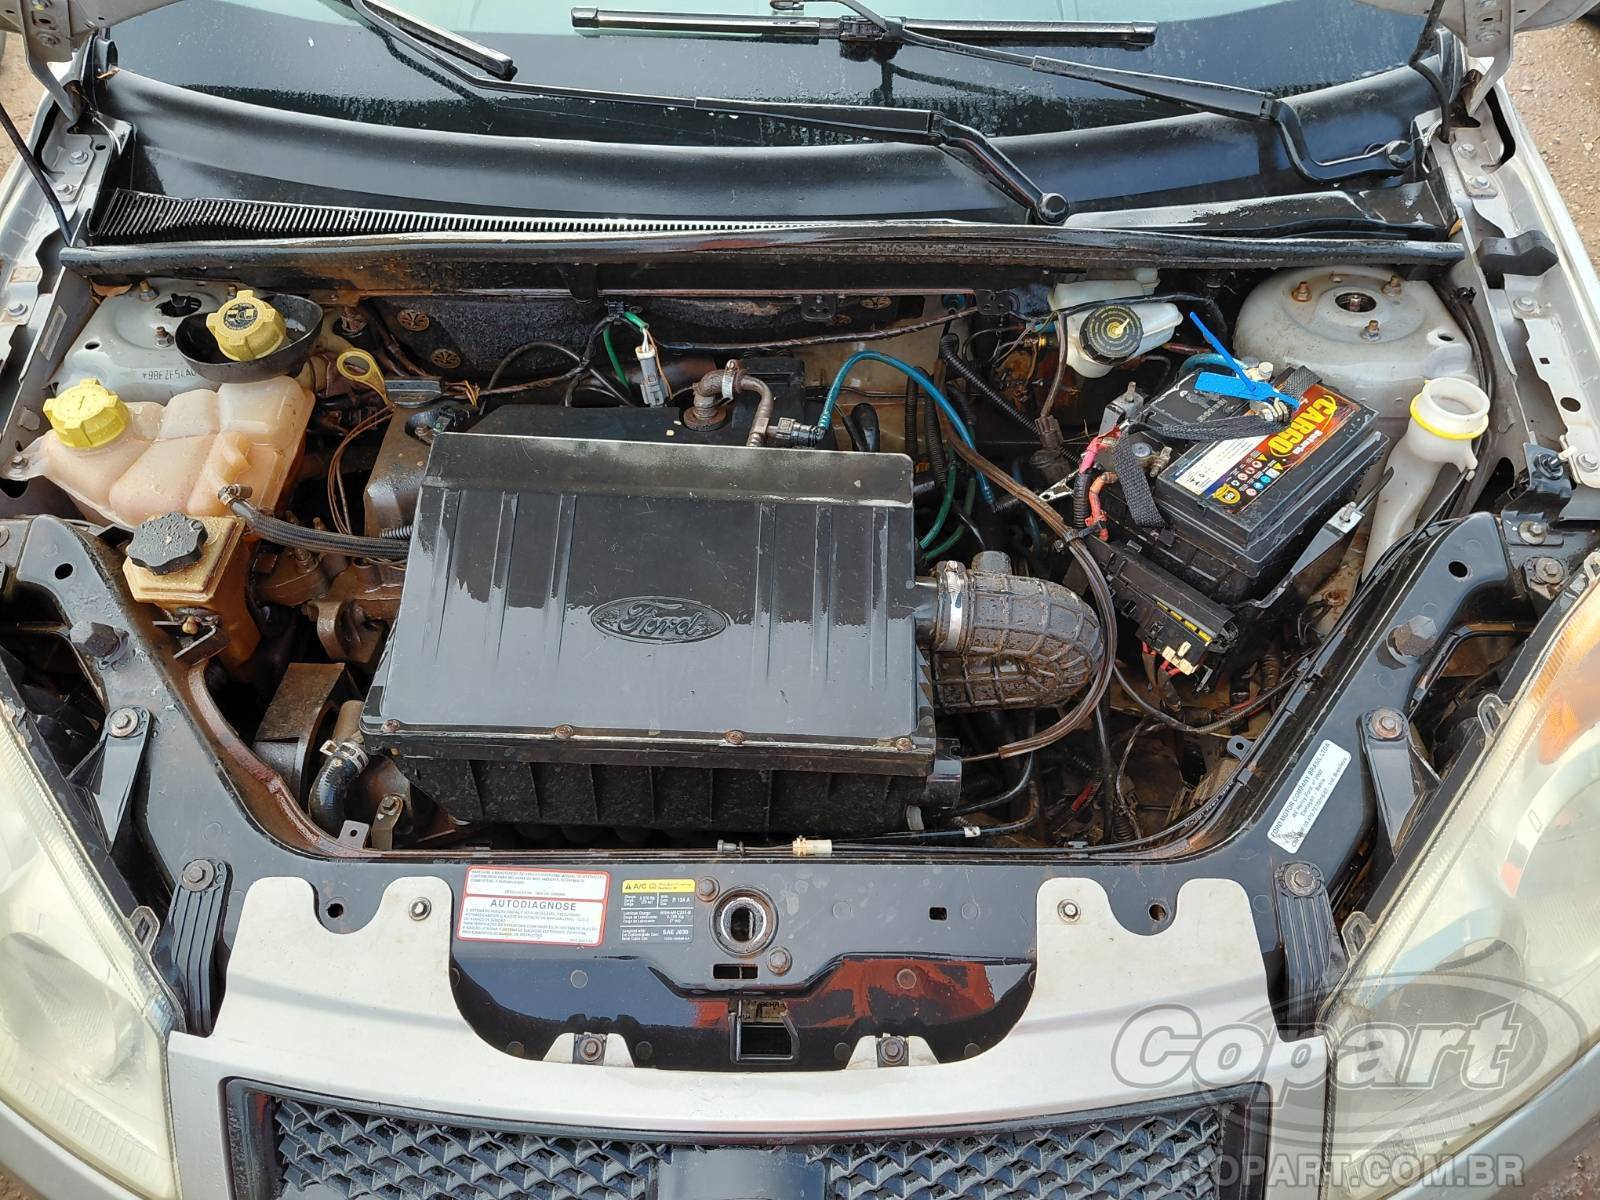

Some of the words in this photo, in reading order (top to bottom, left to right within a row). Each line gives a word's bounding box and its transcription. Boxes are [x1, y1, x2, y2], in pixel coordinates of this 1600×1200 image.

[1268, 397, 1338, 455] CARGO
[619, 600, 703, 635] Ford
[1269, 820, 1283, 837] FORD
[1279, 800, 1295, 822] MOTOR
[1290, 775, 1311, 802] COMPANY
[490, 899, 577, 911] AUTODIAGNOSE
